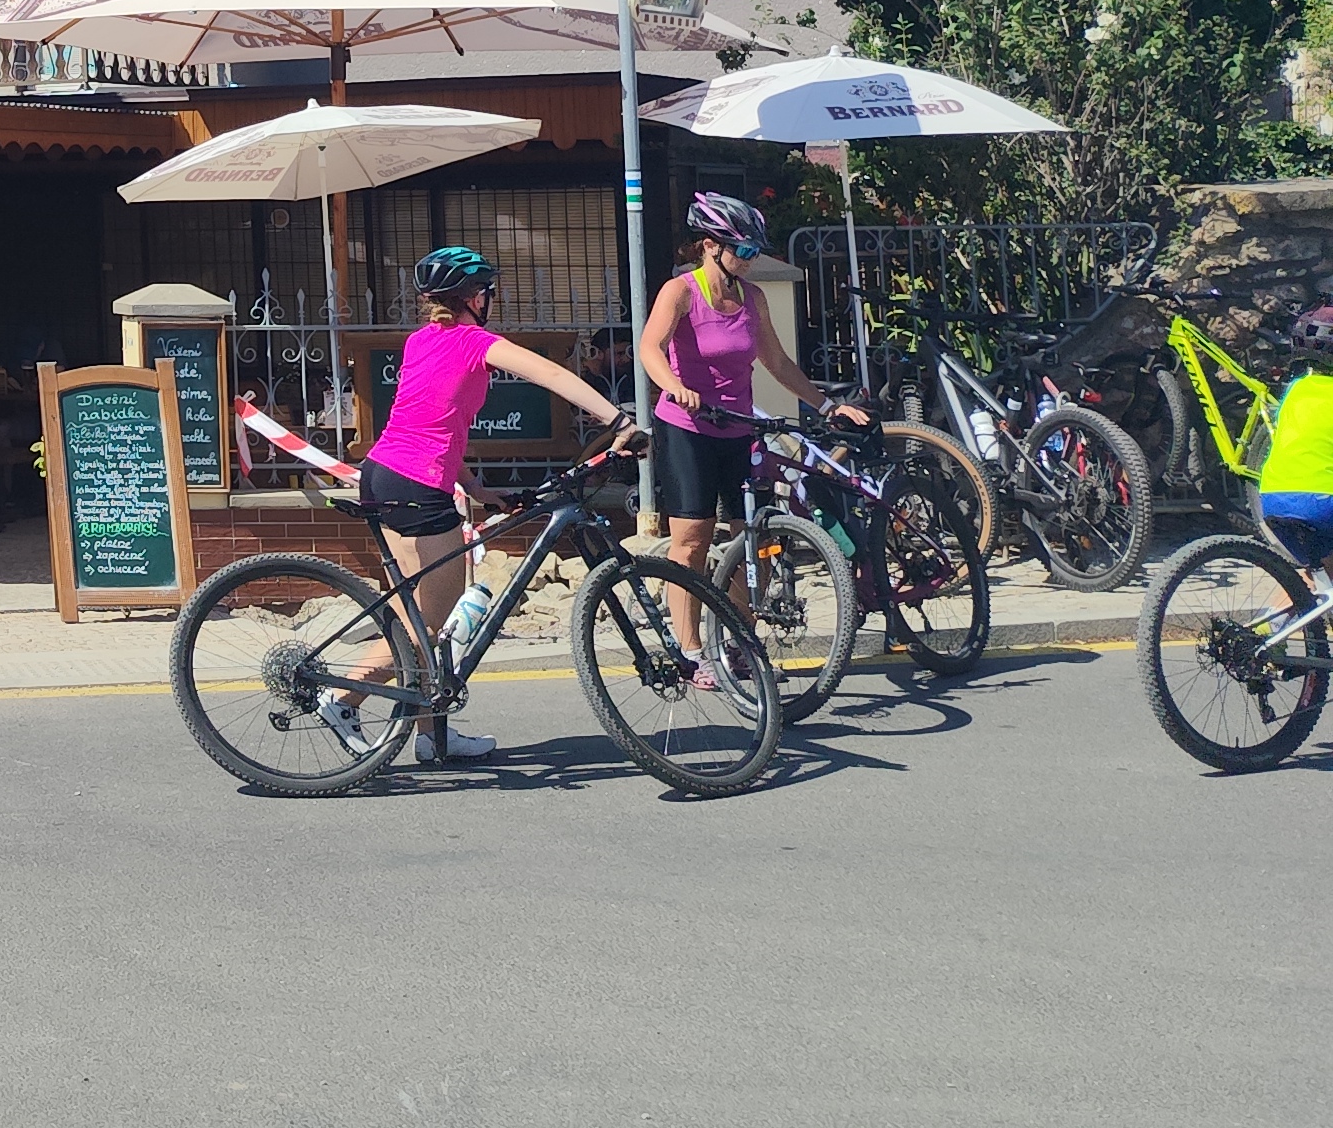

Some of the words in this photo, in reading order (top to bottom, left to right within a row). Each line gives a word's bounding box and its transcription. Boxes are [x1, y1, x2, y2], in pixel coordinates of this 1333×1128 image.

[825, 99, 965, 120] BERNARD
[157, 337, 203, 357] Vážení
[175, 362, 202, 380] sté,
[76, 392, 138, 406] Dnešní
[78, 406, 151, 421] nabídka
[186, 407, 215, 422] kola
